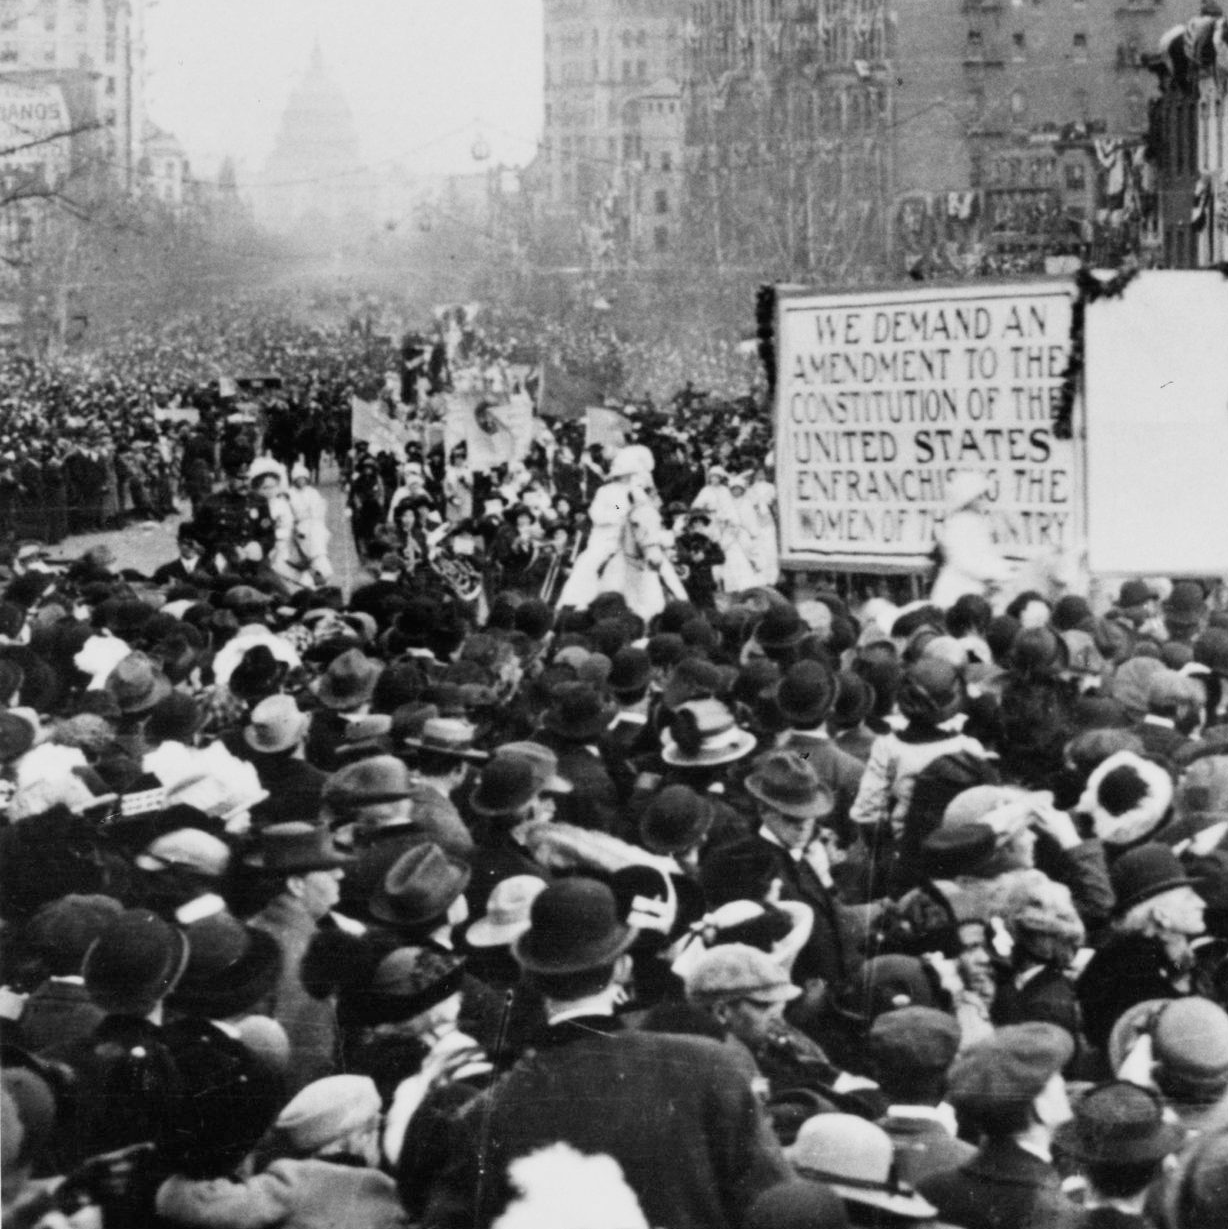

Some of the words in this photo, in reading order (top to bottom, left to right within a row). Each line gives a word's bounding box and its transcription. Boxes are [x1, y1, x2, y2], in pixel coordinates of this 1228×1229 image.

[815, 313, 861, 344] WE
[873, 307, 991, 342] DEMAND
[1002, 304, 1047, 339] AN
[793, 348, 952, 384] AMENDMENT
[966, 348, 998, 381] TO
[1010, 344, 1064, 378] THE
[790, 388, 958, 425] CONSTITUTION
[969, 387, 1000, 422] OF
[1011, 385, 1064, 420] THE
[793, 429, 897, 464] UNITED
[915, 427, 1052, 463] STATES
[796, 469, 1000, 502] ENFRANCHIG
[1013, 468, 1068, 504] THE
[797, 508, 875, 543] WOMEN
[881, 508, 910, 543] OF
[917, 508, 951, 542] TH
